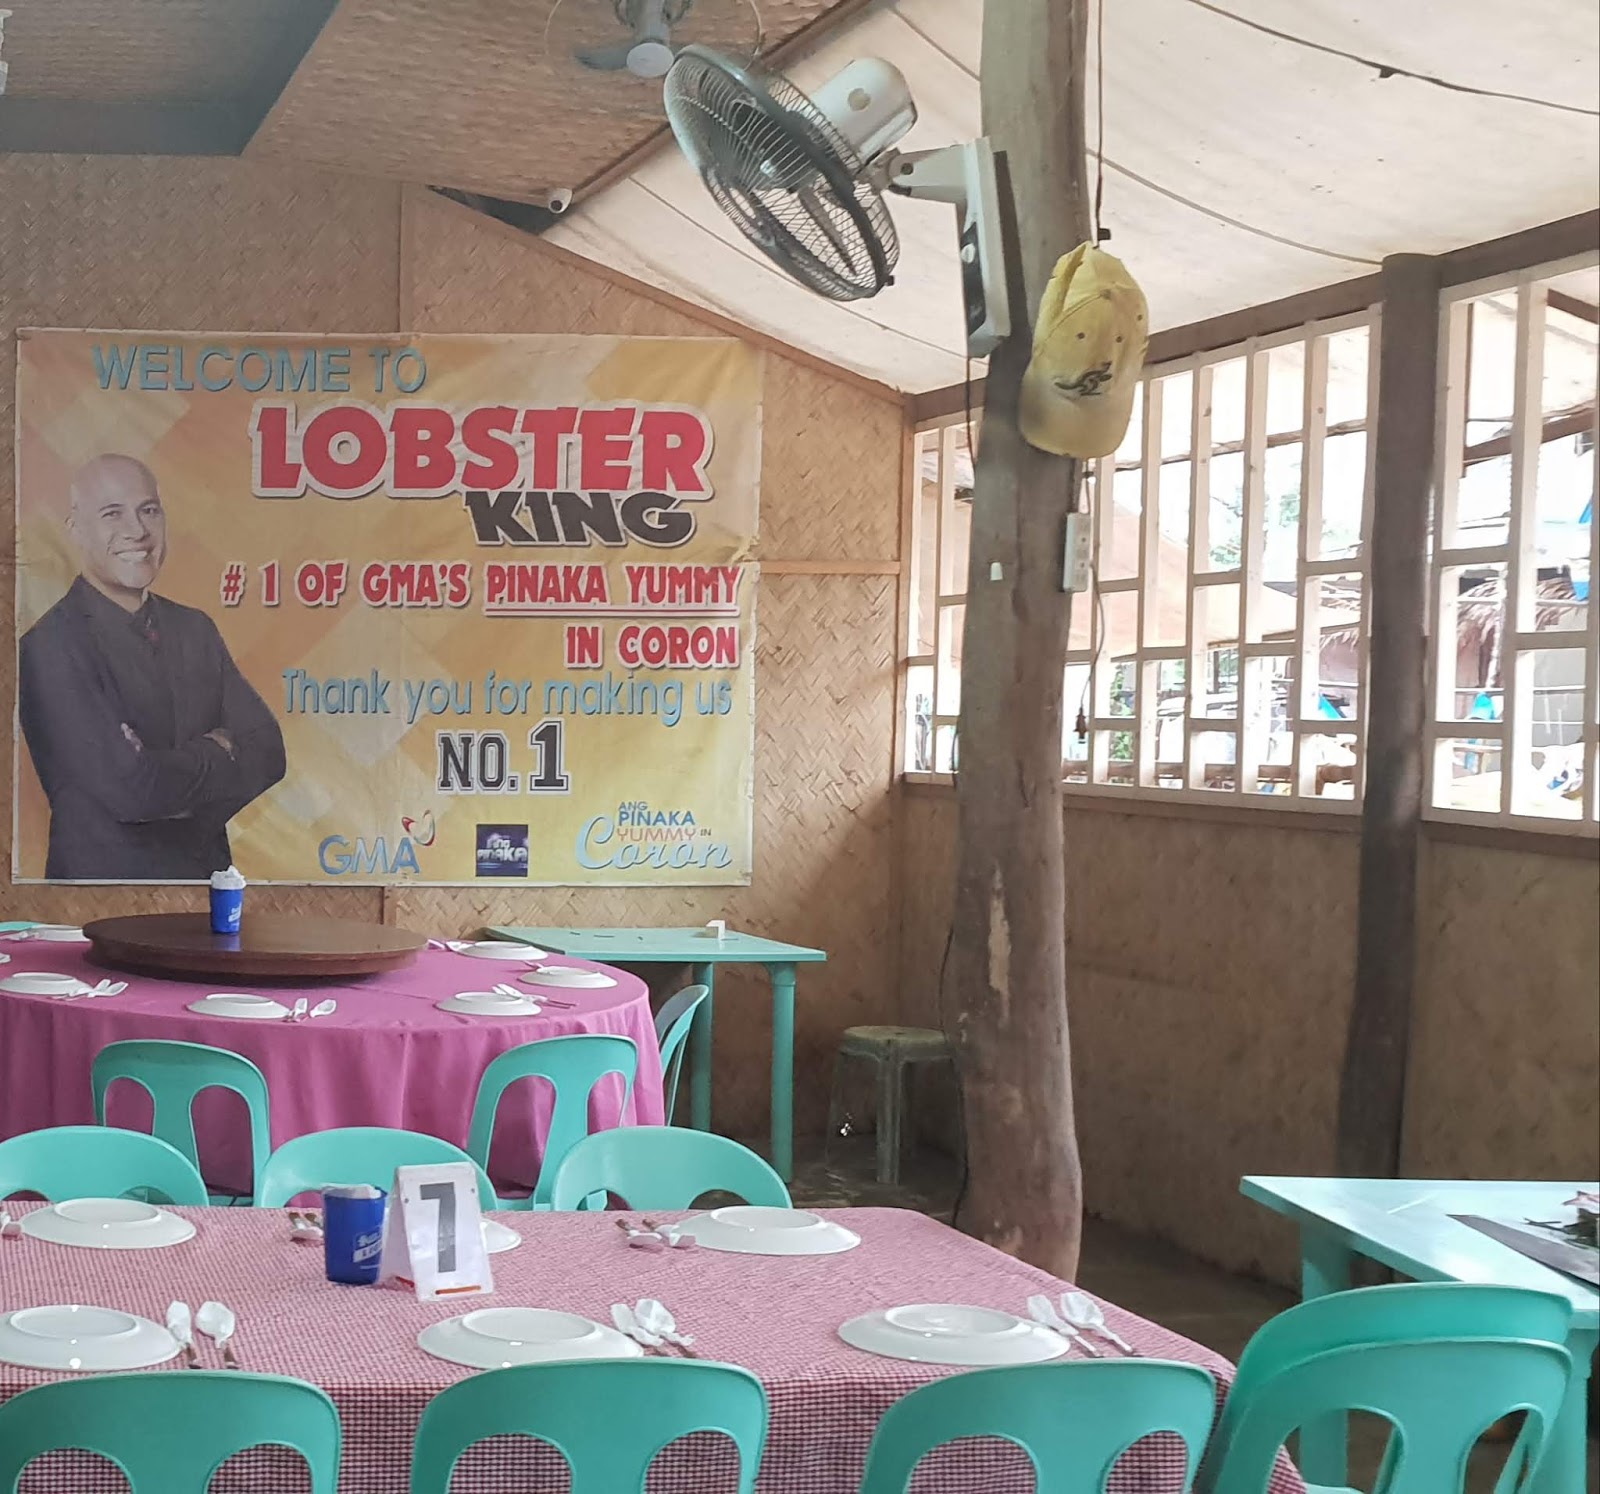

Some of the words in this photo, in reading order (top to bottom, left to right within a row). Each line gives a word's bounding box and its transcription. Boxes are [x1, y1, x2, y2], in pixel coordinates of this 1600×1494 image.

[92, 345, 351, 393] WELCOME
[369, 347, 427, 393] TO
[252, 402, 713, 499] LOBSTER
[464, 490, 696, 546] KING
[221, 561, 246, 605] #
[260, 560, 280, 606] 1
[295, 560, 348, 606] OF
[359, 560, 471, 607] GMA'S
[485, 562, 610, 606] PINAKA
[624, 563, 744, 606] YUMMY
[564, 624, 603, 668] IN
[617, 624, 740, 668] CORON
[282, 668, 391, 714] Thank
[404, 677, 472, 724] you
[484, 670, 532, 714] for
[543, 670, 683, 727] making
[695, 679, 733, 715] us
[618, 801, 648, 811] ANG
[618, 811, 695, 826] PINAKA
[318, 834, 421, 875] GMA
[575, 814, 733, 870] Coron
[617, 827, 697, 842] YUMMY
[700, 828, 712, 837] IN
